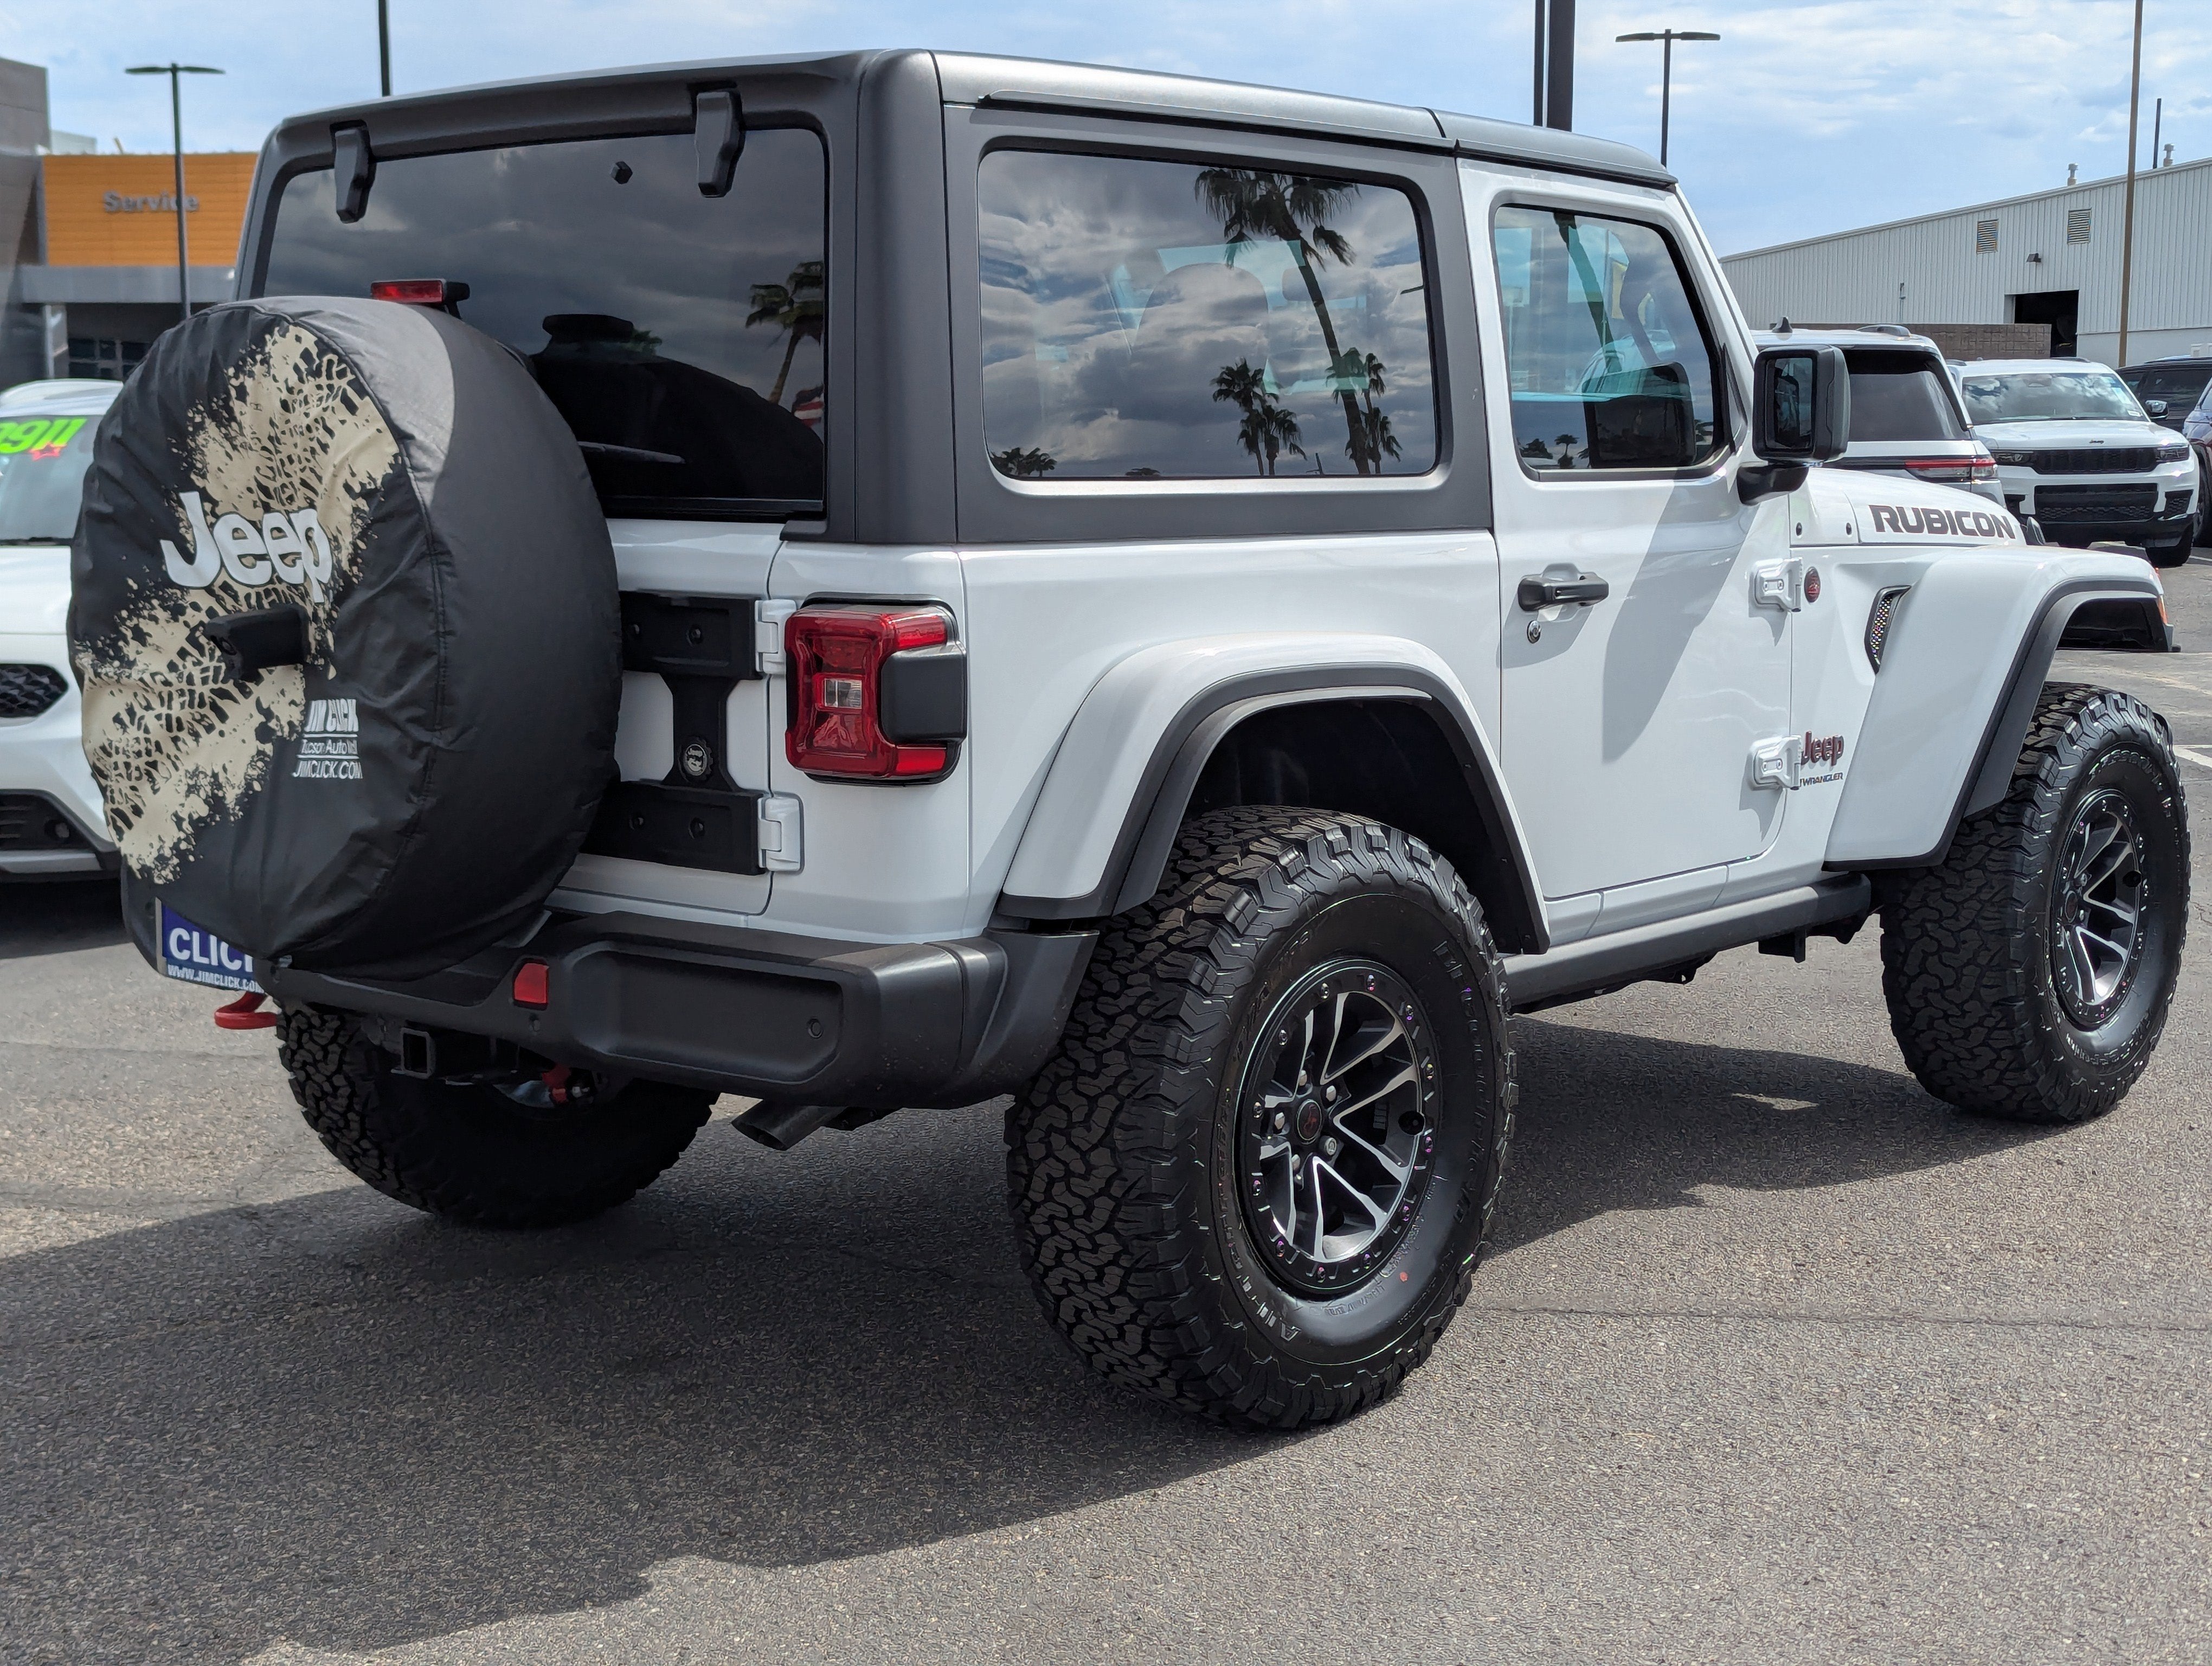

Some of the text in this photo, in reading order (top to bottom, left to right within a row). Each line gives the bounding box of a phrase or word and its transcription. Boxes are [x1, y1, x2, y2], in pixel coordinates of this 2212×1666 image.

[103, 190, 199, 212] Service
[1868, 504, 2016, 539] RUBICON
[160, 491, 333, 603] Jeep
[326, 699, 359, 732] CLICK
[1801, 731, 1844, 766] Jeep
[1801, 772, 1843, 786] WRANGLER
